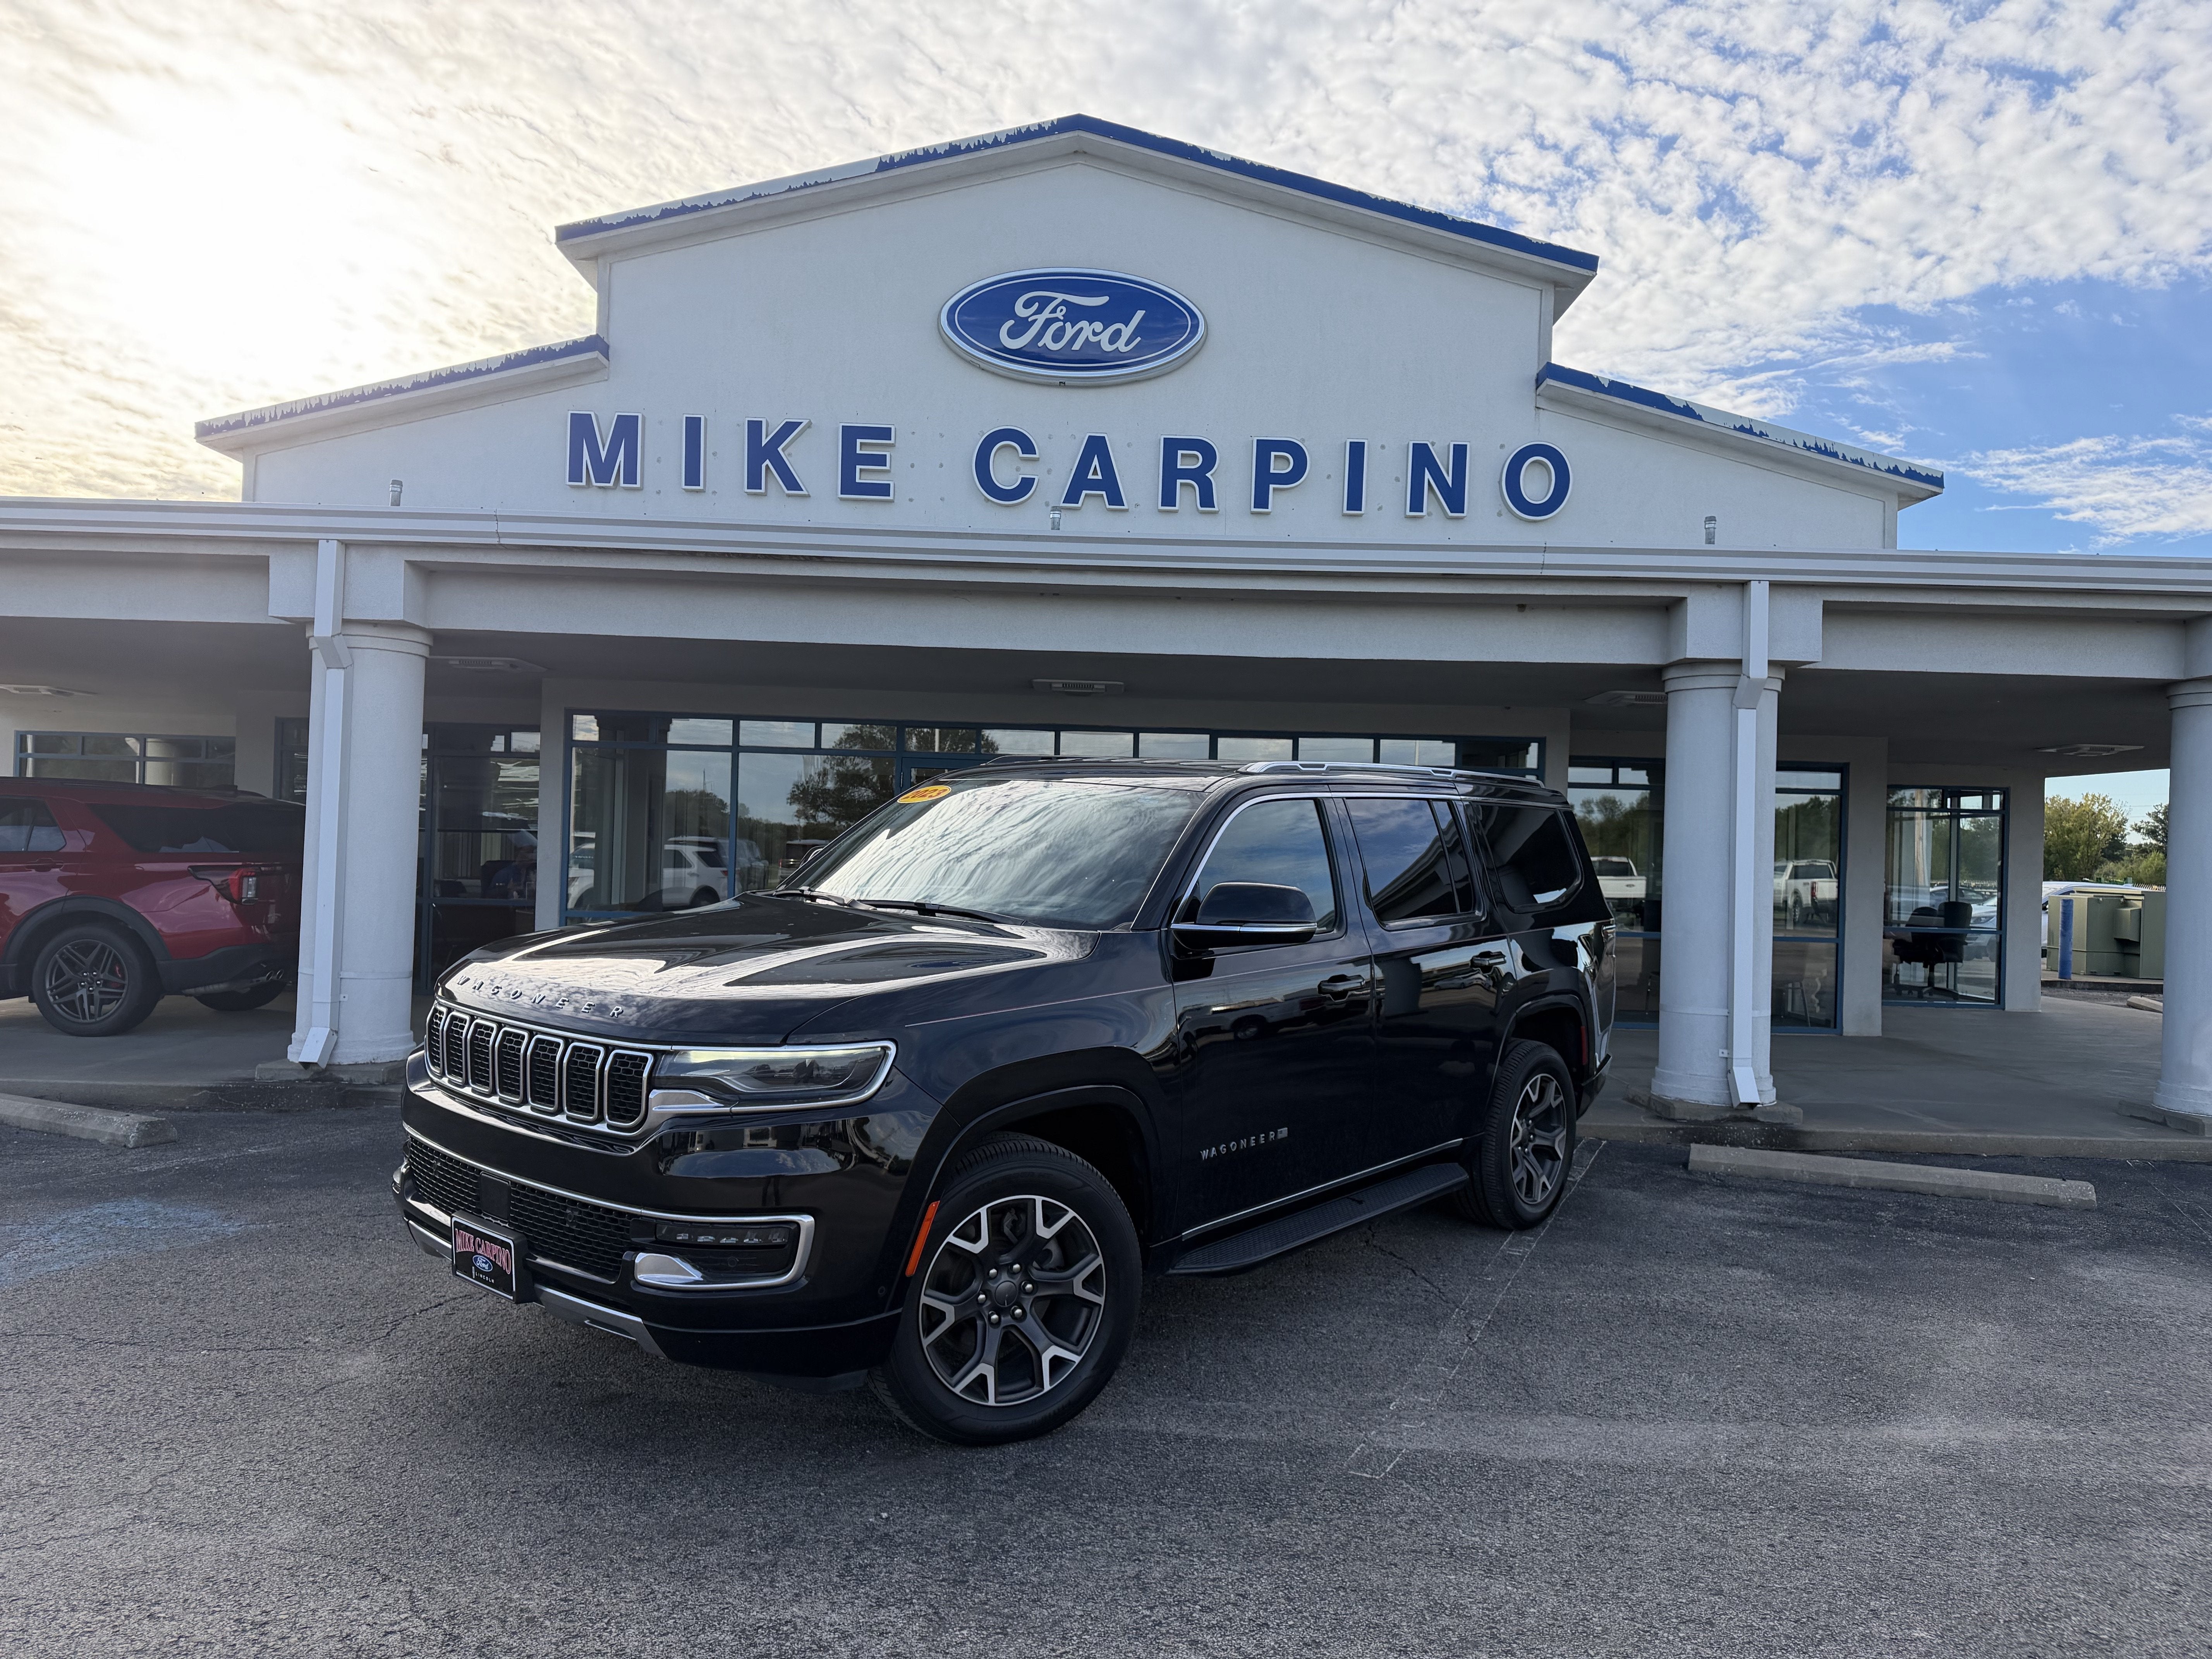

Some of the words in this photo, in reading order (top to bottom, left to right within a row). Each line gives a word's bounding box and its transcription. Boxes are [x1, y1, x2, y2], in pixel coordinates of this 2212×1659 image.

[1000, 291, 1146, 352] Ford
[565, 410, 895, 502] MIKE
[972, 425, 1573, 522] CARPINO
[901, 789, 948, 800] 2023
[456, 975, 624, 1018] WAGONEER
[1200, 1131, 1275, 1160] WAGONEER
[455, 1228, 474, 1253] MIKE
[475, 1237, 511, 1274] CARPINO
[476, 1257, 489, 1270] Ford
[475, 1271, 494, 1283] LINCOLN
